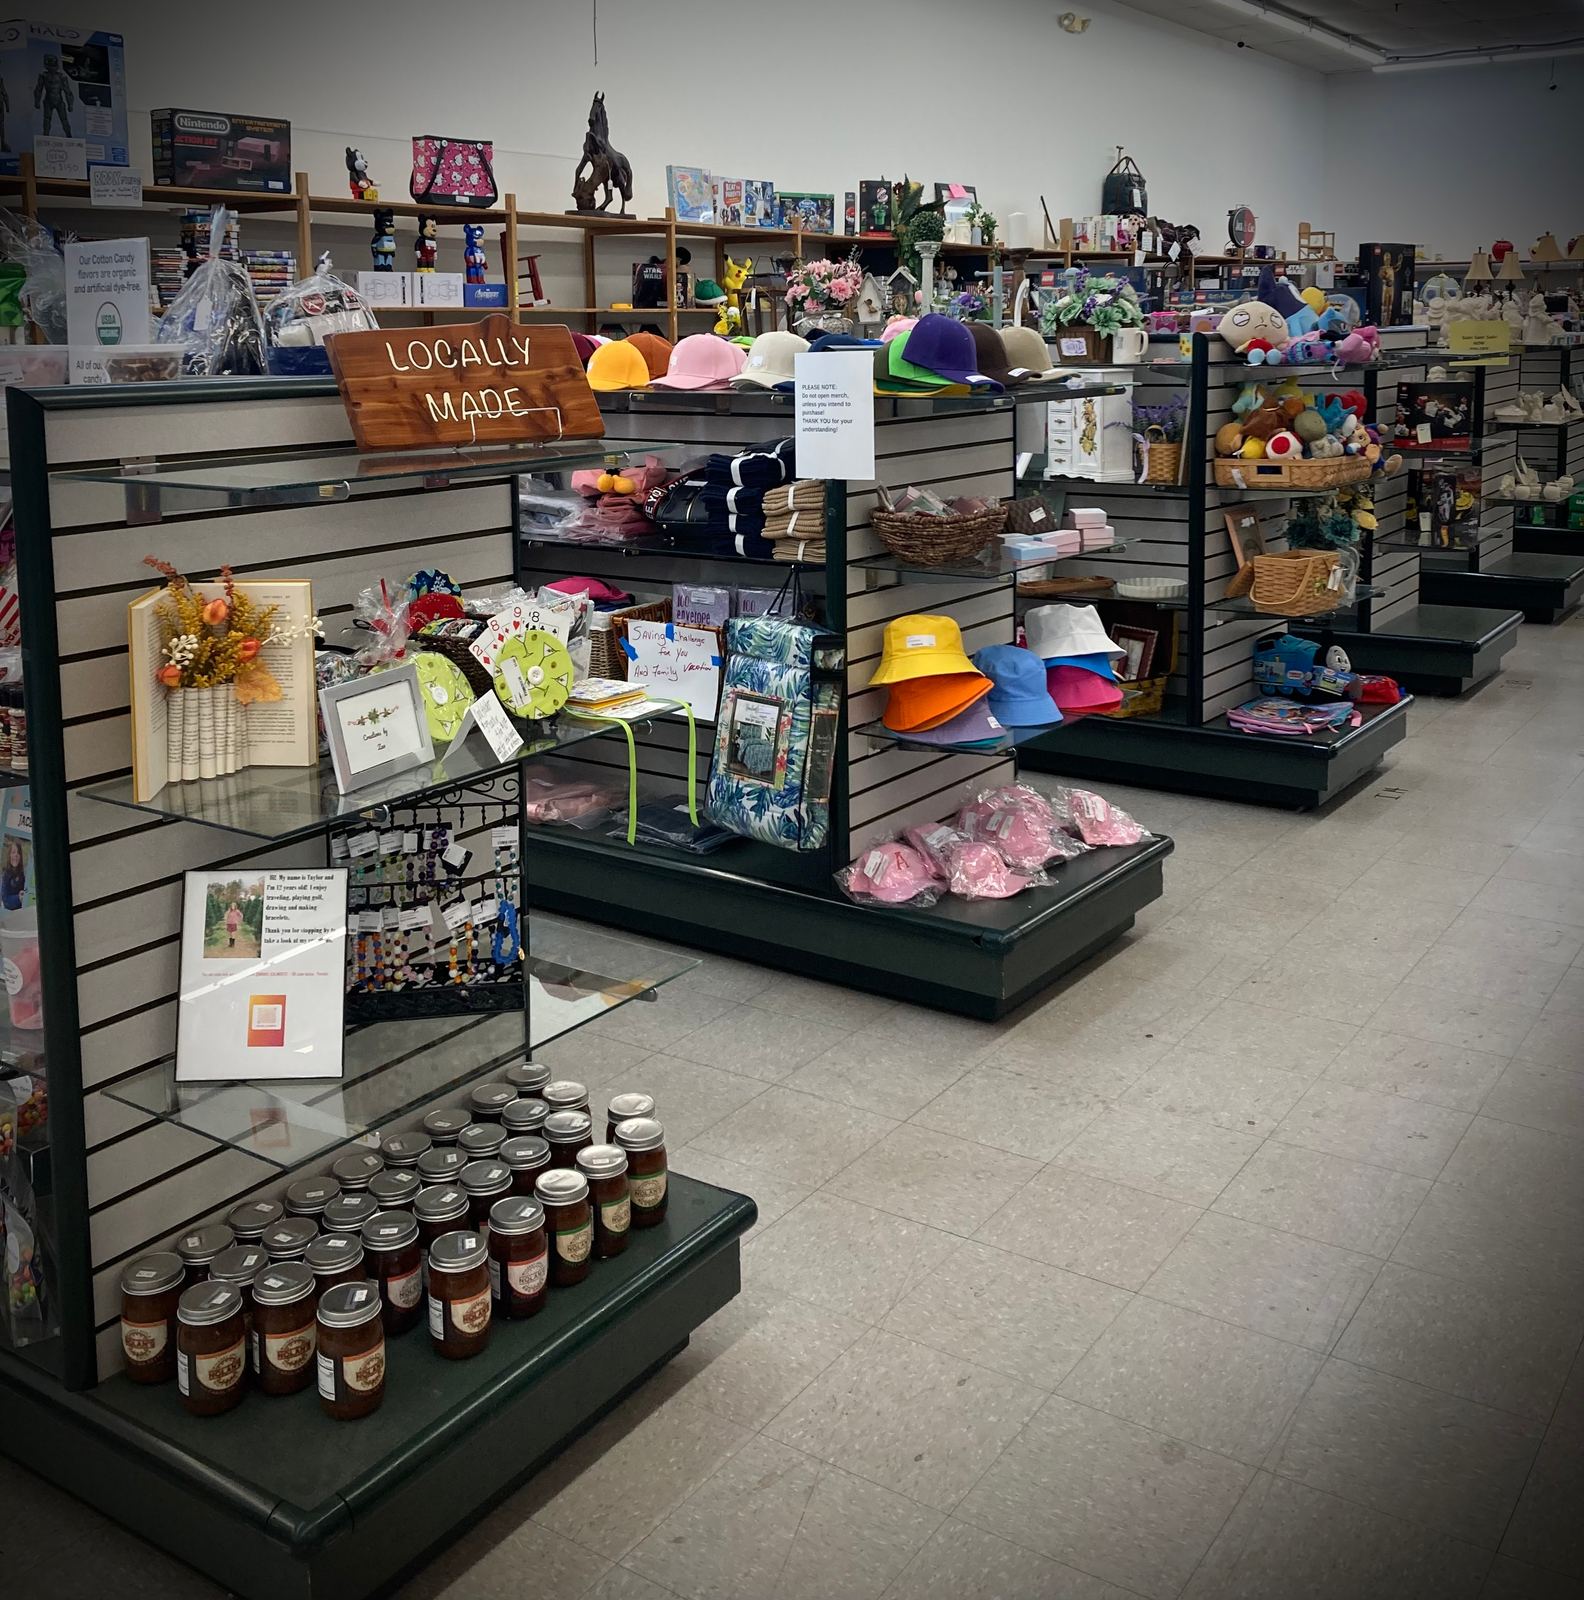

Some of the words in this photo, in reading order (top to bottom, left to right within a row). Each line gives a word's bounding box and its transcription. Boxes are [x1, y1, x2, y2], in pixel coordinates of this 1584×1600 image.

[30, 24, 80, 40] HALO
[179, 116, 227, 131] Nintendo
[79, 255, 91, 265] Our
[92, 254, 114, 264] Cotton
[114, 253, 135, 265] Candy
[78, 270, 99, 280] flavors
[100, 270, 111, 279] are
[112, 268, 136, 280] organic
[74, 284, 86, 293] and
[86, 283, 113, 293] artificial
[113, 282, 141, 294] dye-free.
[101, 314, 116, 325] USDA
[385, 337, 530, 372] LOCALLY
[76, 360, 84, 369] All
[85, 360, 92, 369] of
[425, 387, 529, 424] MADE
[676, 594, 690, 608] 100
[513, 606, 522, 618] 9
[531, 610, 540, 623] 8
[676, 610, 711, 625] envelope
[490, 619, 500, 632] 8
[632, 625, 666, 646] Saving
[673, 631, 705, 647] Challenge
[472, 643, 484, 657] 2
[633, 665, 649, 678] And
[652, 664, 678, 682] Family
[382, 727, 388, 737] by
[307, 874, 324, 882] Taylor
[313, 884, 327, 892] enjoy
[292, 894, 311, 902] playing
[300, 927, 322, 935] stopping
[323, 927, 329, 935] by
